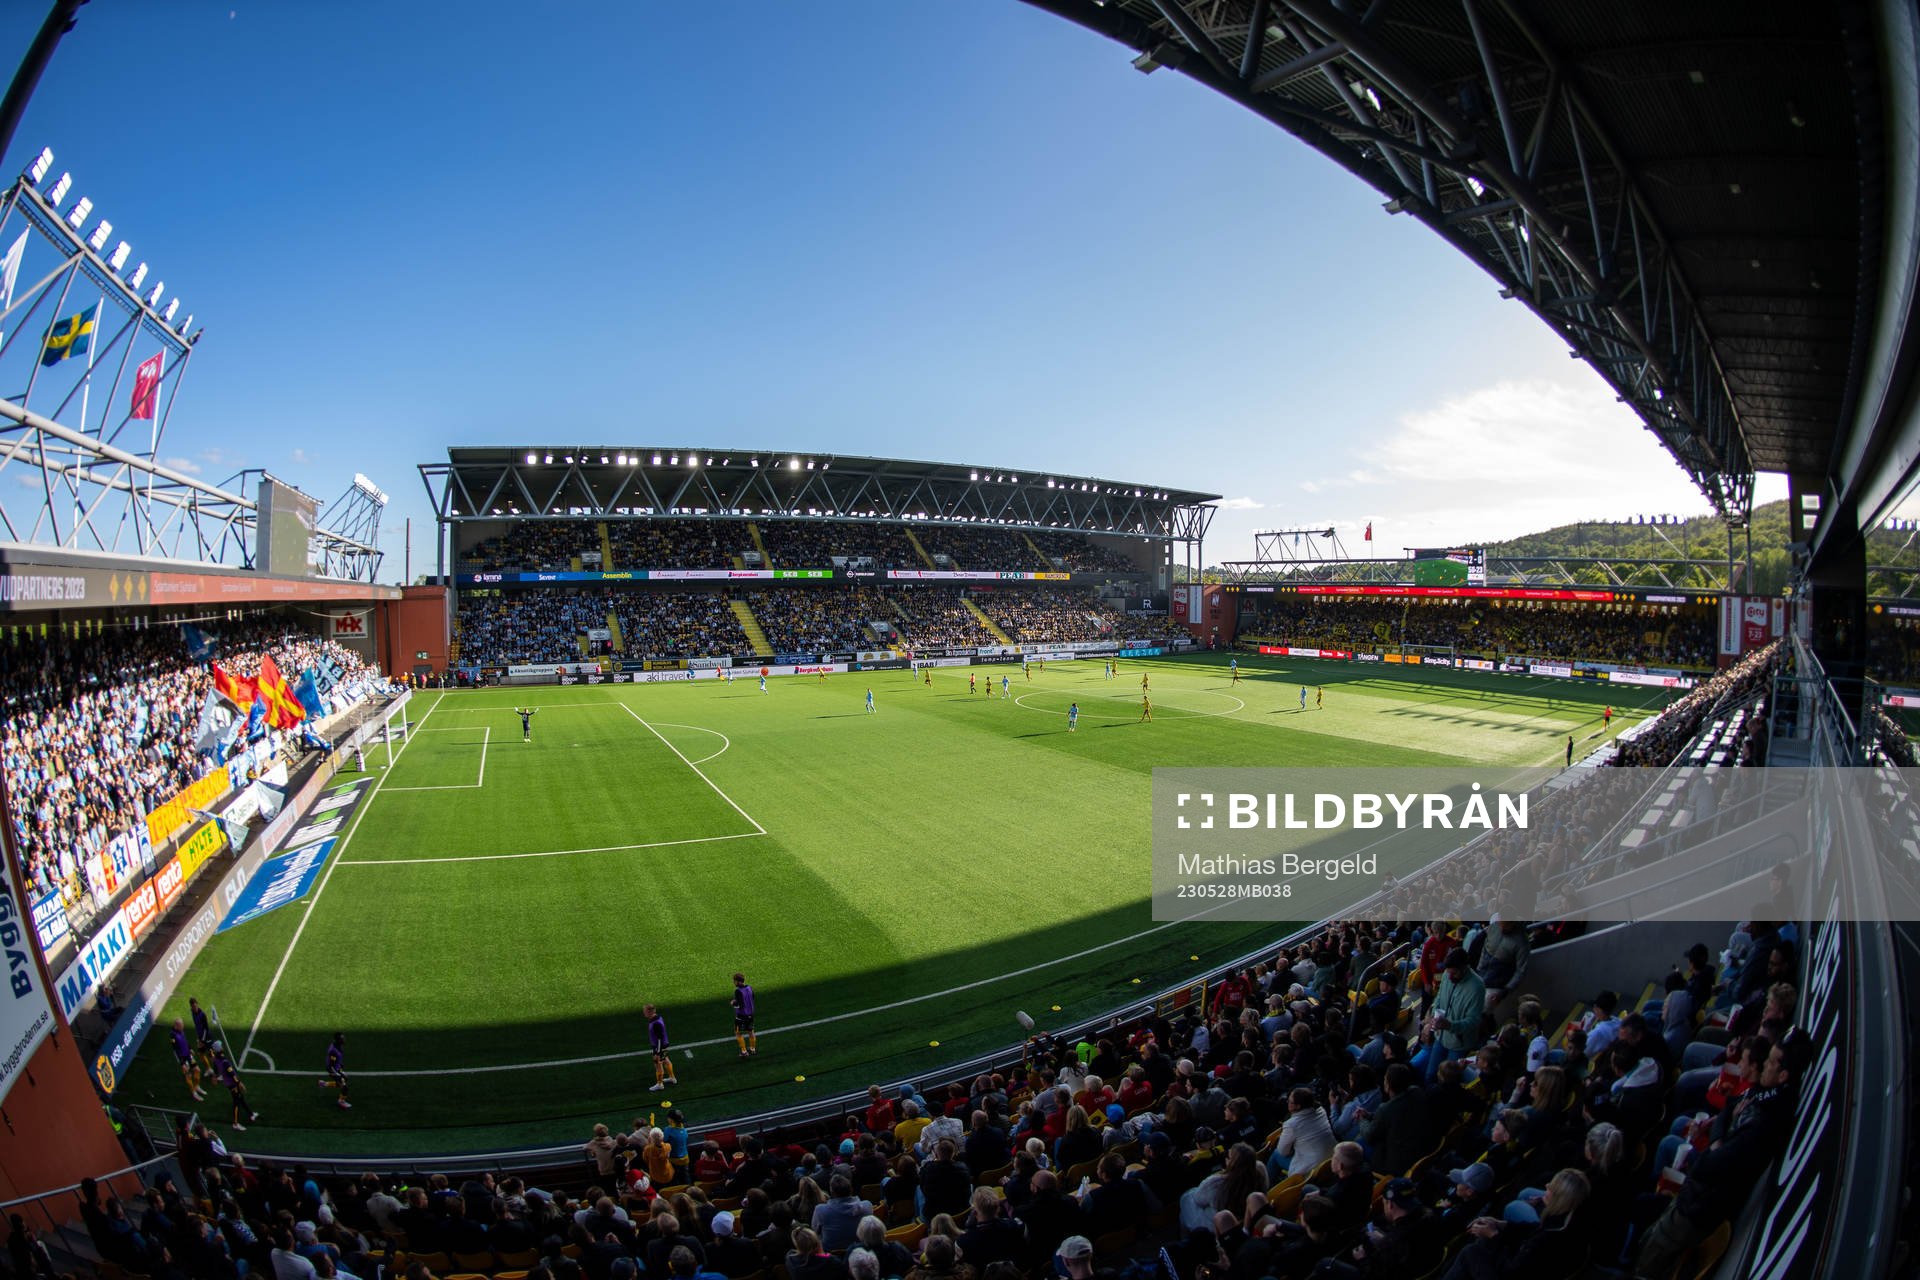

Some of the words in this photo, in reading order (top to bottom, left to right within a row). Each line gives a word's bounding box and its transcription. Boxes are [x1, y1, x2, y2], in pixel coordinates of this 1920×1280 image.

[64, 577, 86, 600] 2023
[602, 571, 632, 579] Assemblin
[661, 671, 686, 681] travel
[189, 826, 214, 862] HYLTE
[158, 860, 183, 900] renta
[125, 885, 156, 929] renta
[165, 905, 217, 979] STADSPORTEN
[60, 921, 128, 1016] MATAKI
